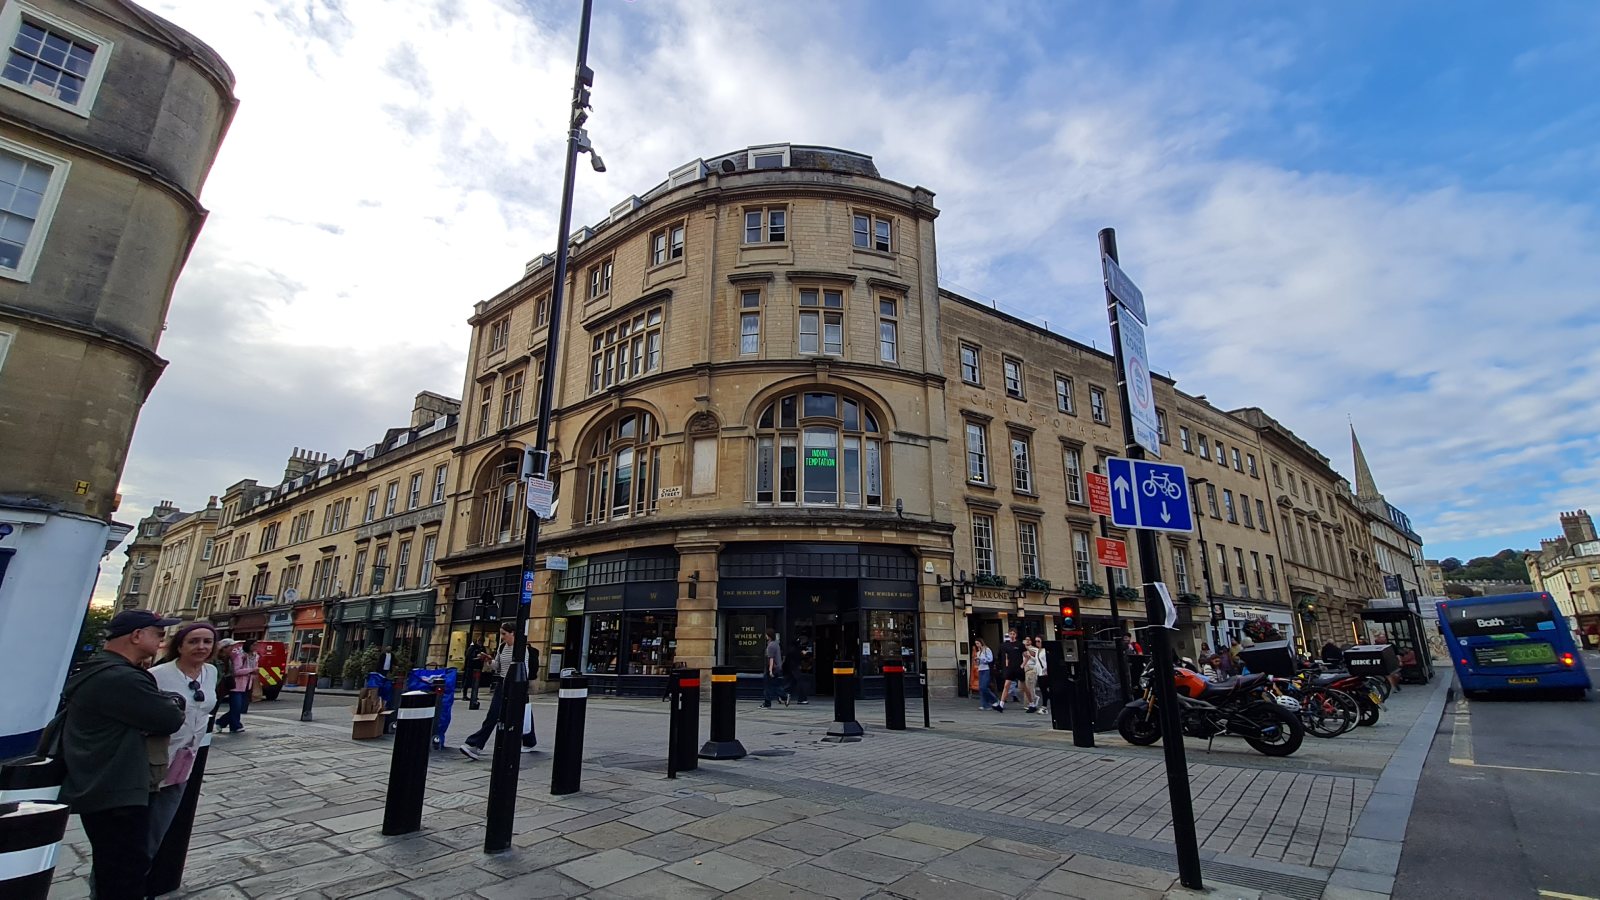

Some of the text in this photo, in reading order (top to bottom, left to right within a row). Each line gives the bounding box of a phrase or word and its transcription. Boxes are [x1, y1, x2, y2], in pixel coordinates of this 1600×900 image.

[1125, 333, 1143, 358] ZONE
[971, 394, 1109, 442] CHRISTOPHER
[811, 449, 828, 457] INDIAN
[805, 457, 835, 467] TEMPTATION
[76, 482, 89, 494] H
[811, 595, 820, 603] W
[993, 592, 1008, 600] ONE
[1476, 617, 1505, 628] Bath
[1351, 658, 1371, 666] BIKE
